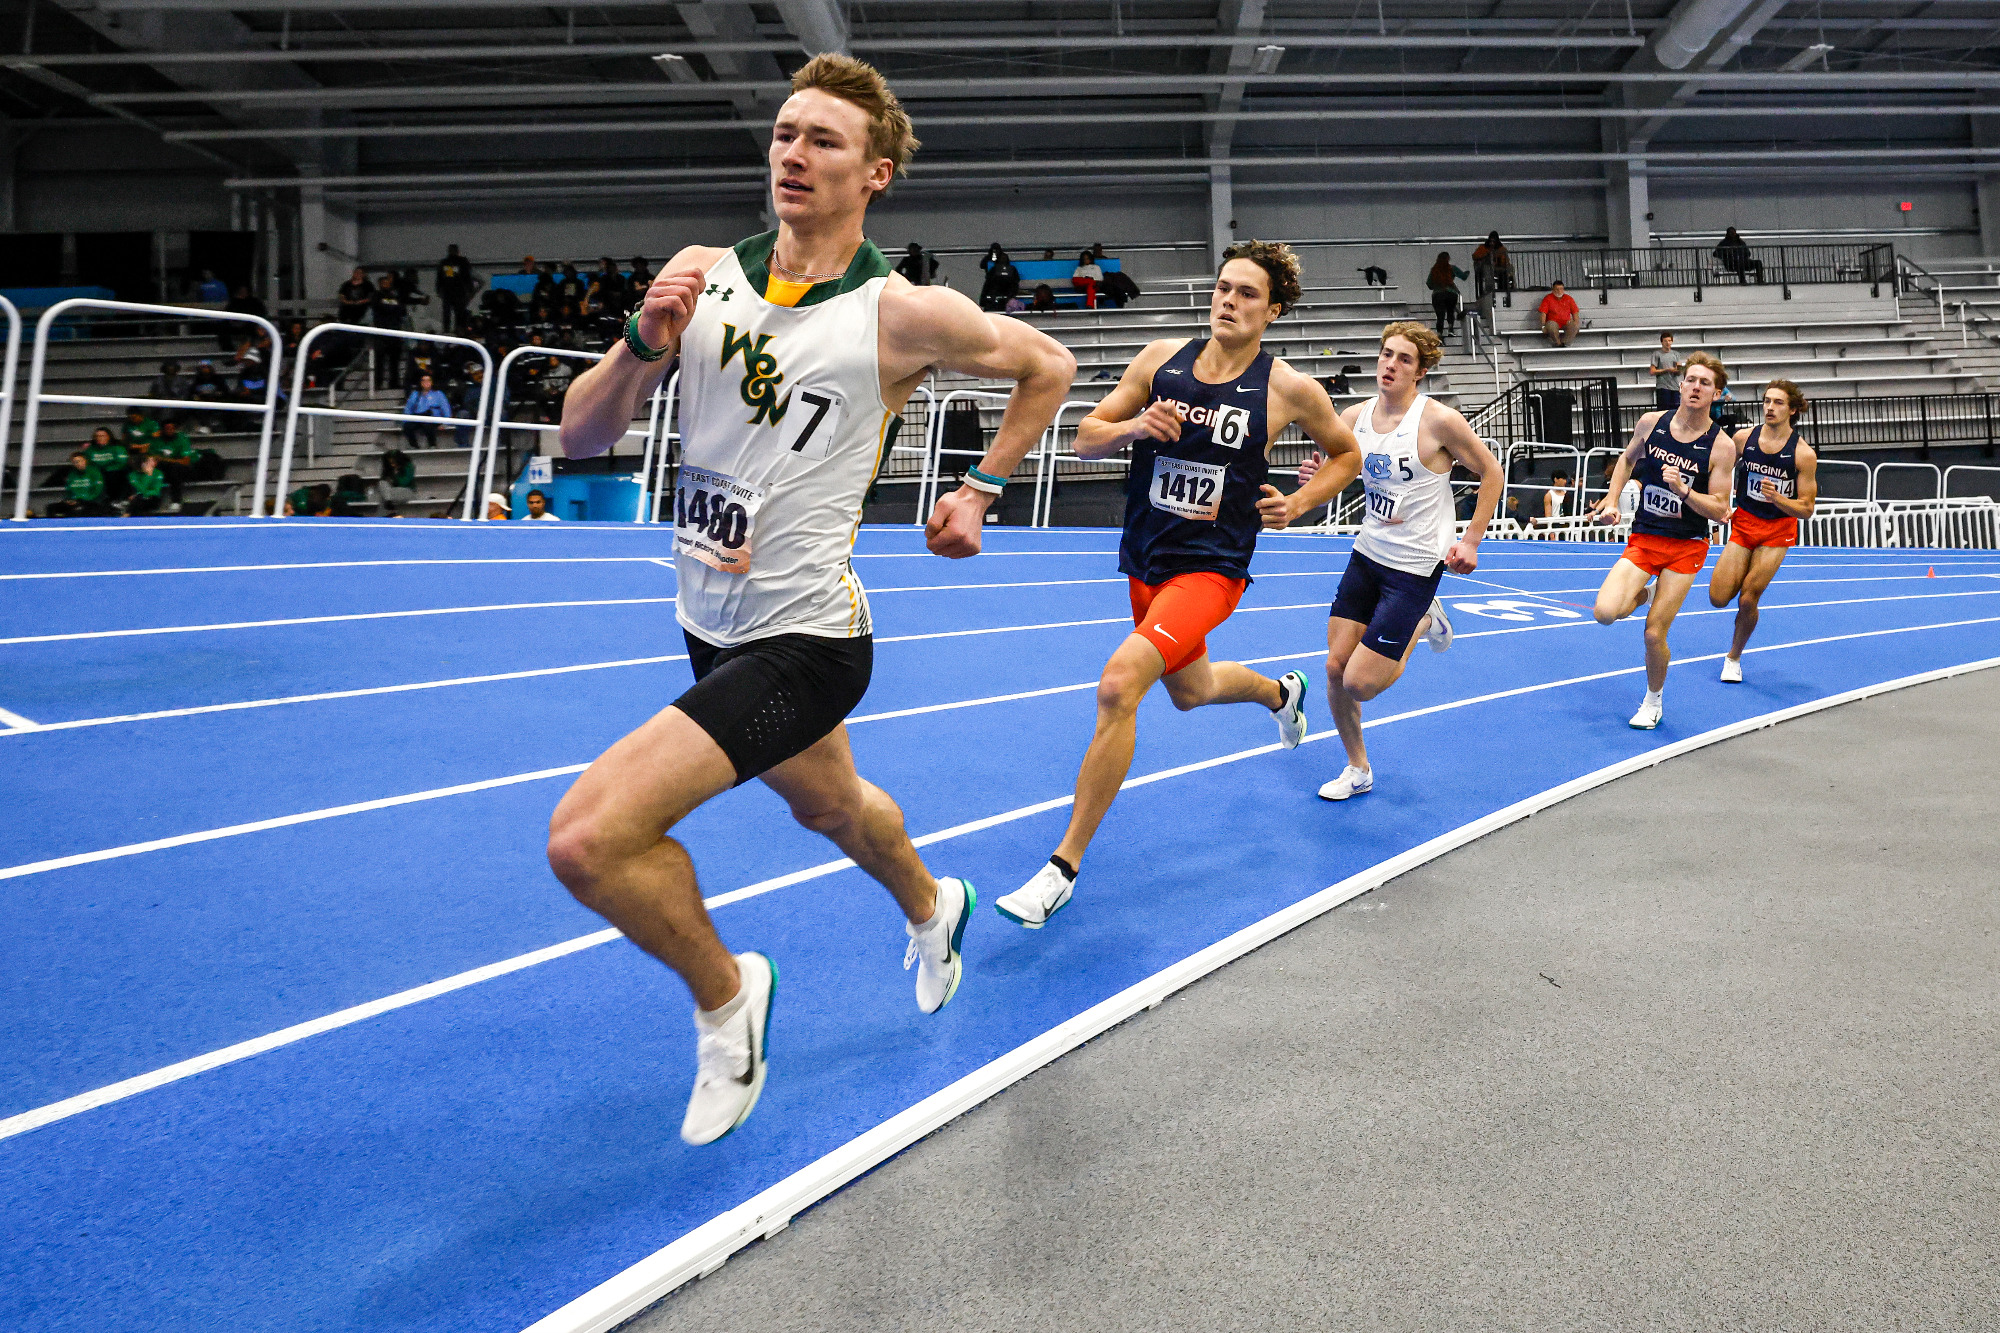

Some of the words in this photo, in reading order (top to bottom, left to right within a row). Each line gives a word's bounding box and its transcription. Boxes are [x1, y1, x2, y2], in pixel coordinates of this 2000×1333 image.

[790, 391, 832, 452] 7
[1220, 409, 1243, 444] 6
[1171, 462, 1184, 470] EAST
[1398, 456, 1414, 481] 5
[1648, 443, 1700, 474] VIRGINIA
[1744, 460, 1789, 479] VIRGINIA
[691, 472, 711, 484] EAST
[1158, 471, 1216, 507] 1412
[1783, 481, 1793, 497] 4
[1368, 491, 1396, 520] 1277
[1645, 491, 1679, 514] 1420
[677, 486, 748, 550] 1480
